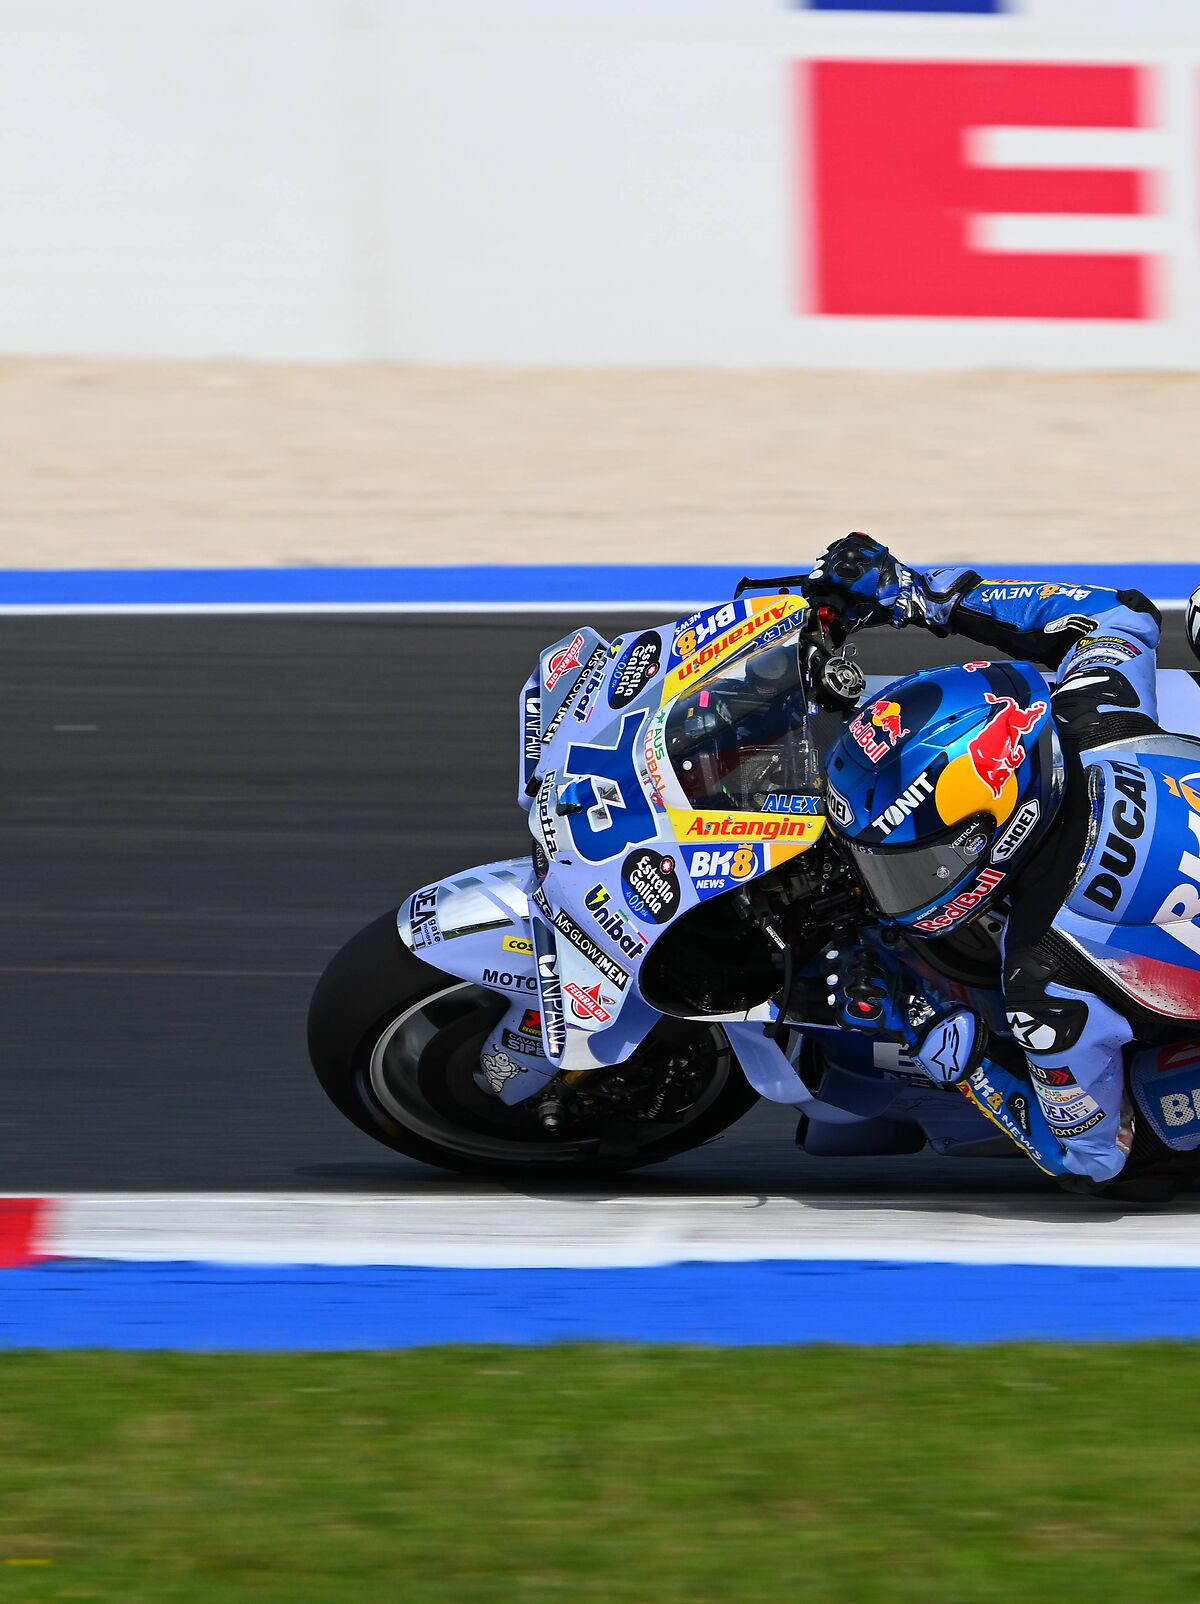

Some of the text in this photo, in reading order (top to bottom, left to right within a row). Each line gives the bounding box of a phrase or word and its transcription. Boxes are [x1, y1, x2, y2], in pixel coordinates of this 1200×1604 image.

[982, 585, 1034, 602] NEWS
[675, 612, 702, 635] NEWS
[677, 602, 736, 656] BK8
[678, 601, 788, 680] Antangin
[753, 608, 806, 648] ALEX
[559, 638, 582, 672] FEDERAL
[616, 646, 644, 695] Galicia
[566, 668, 590, 705] GLOW
[653, 728, 665, 761] AUS
[762, 793, 821, 814] ALEX
[872, 772, 934, 835] TONIT
[686, 817, 805, 840] Antangin
[996, 806, 1037, 857] SHOEI
[637, 855, 674, 904] Estrella
[690, 849, 754, 878] BK8
[629, 869, 662, 914] Galicia
[696, 879, 725, 889] NEWS
[914, 868, 1006, 932] Red Bull
[428, 918, 441, 943] gate
[555, 913, 570, 934] MS
[570, 929, 600, 959] GLOW
[585, 882, 645, 959] Unibat
[567, 984, 607, 1021] FEDERAL OIL
[1002, 1114, 1042, 1160] NEWS
